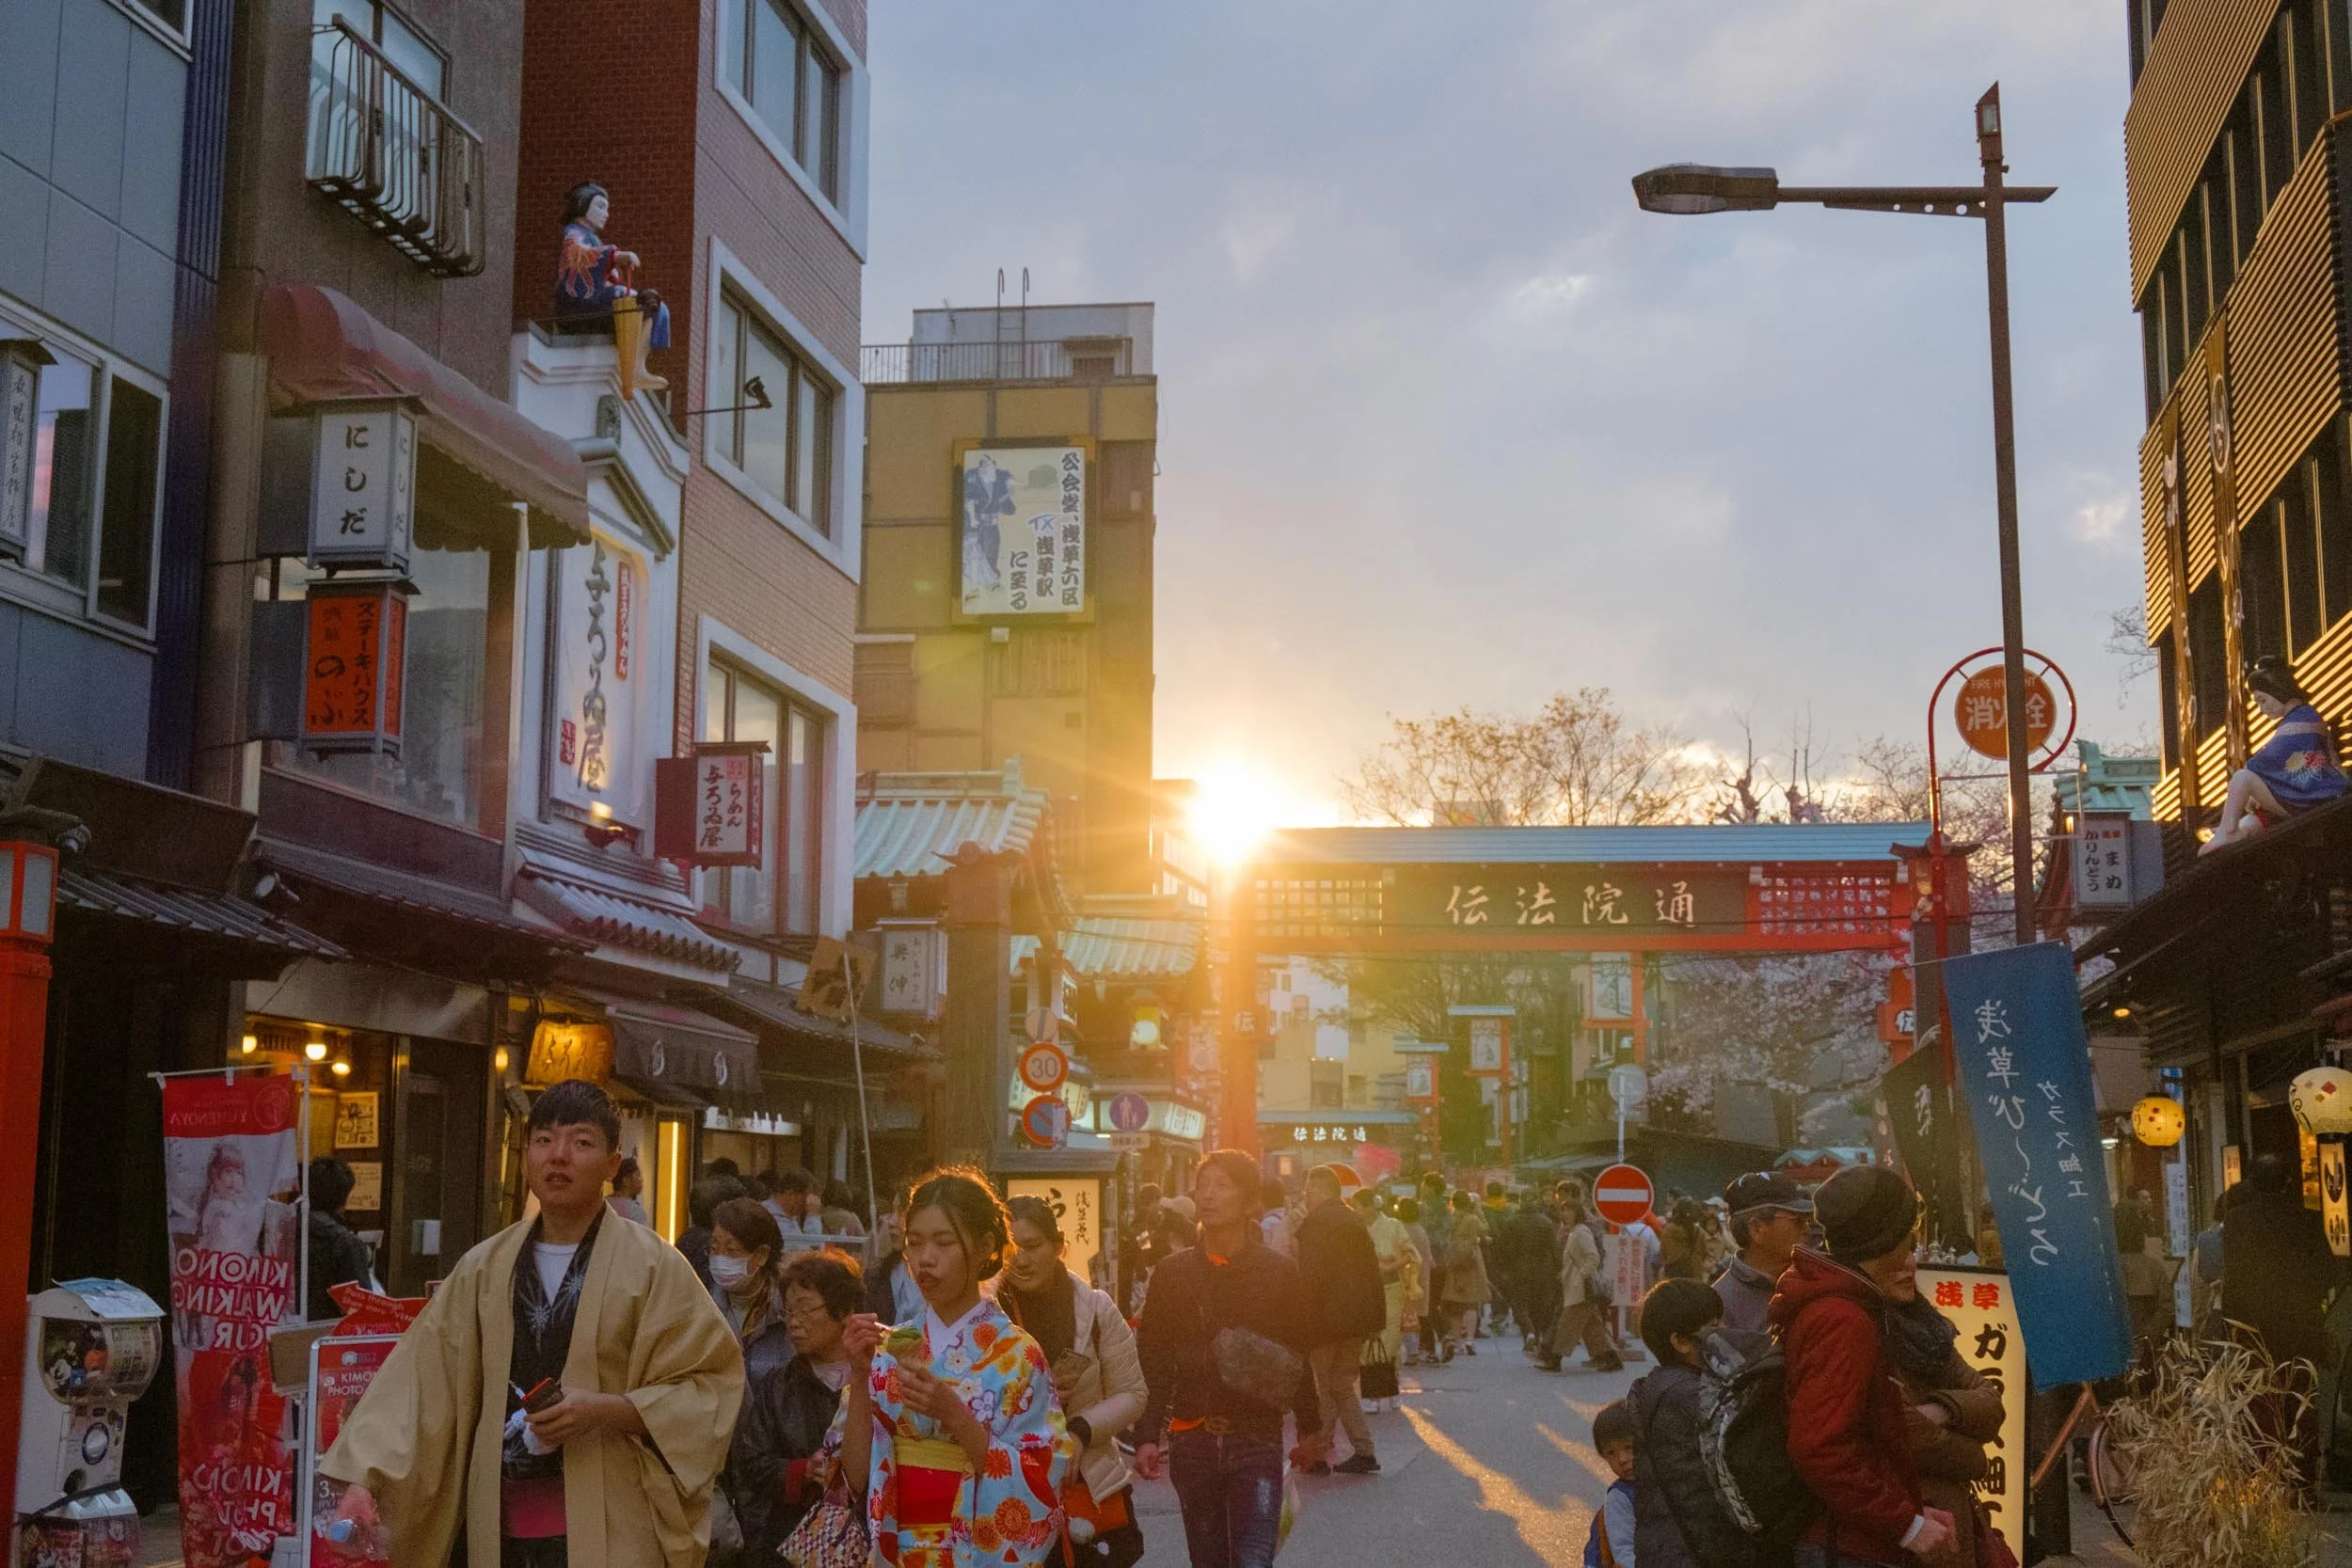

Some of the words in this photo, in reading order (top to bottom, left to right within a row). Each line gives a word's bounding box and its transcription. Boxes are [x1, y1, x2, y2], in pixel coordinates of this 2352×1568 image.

[340, 425, 369, 535] にしだ
[1009, 550, 1029, 610] に至る
[352, 602, 376, 725] ステーキハウス
[1994, 677, 2037, 689] HYNT
[2084, 831, 2100, 893] かりんとう
[2106, 851, 2122, 890] まめ
[1445, 880, 1695, 927] 伝法院通
[1032, 1056, 1058, 1079] 30
[1294, 1126, 1367, 1142] 伝法院通
[1935, 1280, 2000, 1309] 浅草
[327, 1385, 365, 1397] PHOTO
[341, 1371, 376, 1384] KIMO
